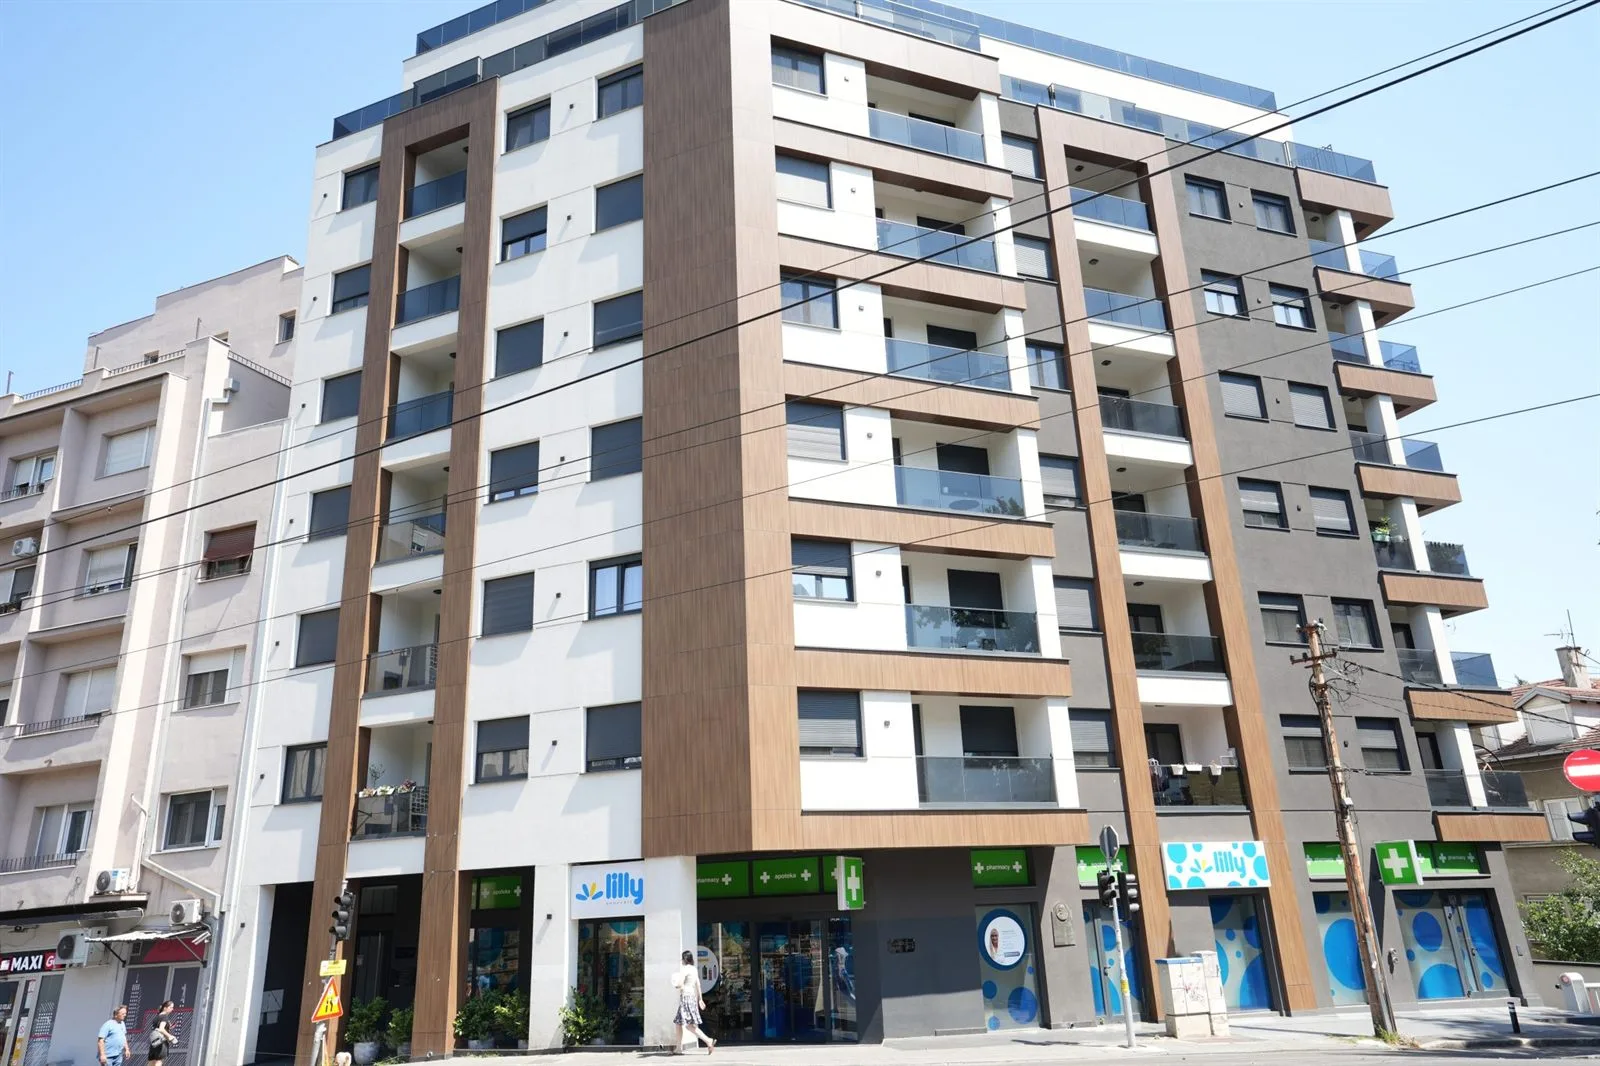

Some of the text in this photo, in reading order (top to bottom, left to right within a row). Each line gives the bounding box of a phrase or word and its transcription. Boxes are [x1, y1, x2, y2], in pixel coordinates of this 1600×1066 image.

[1213, 851, 1246, 879] lilly
[606, 872, 643, 905] lilly
[11, 955, 43, 971] MAXI
